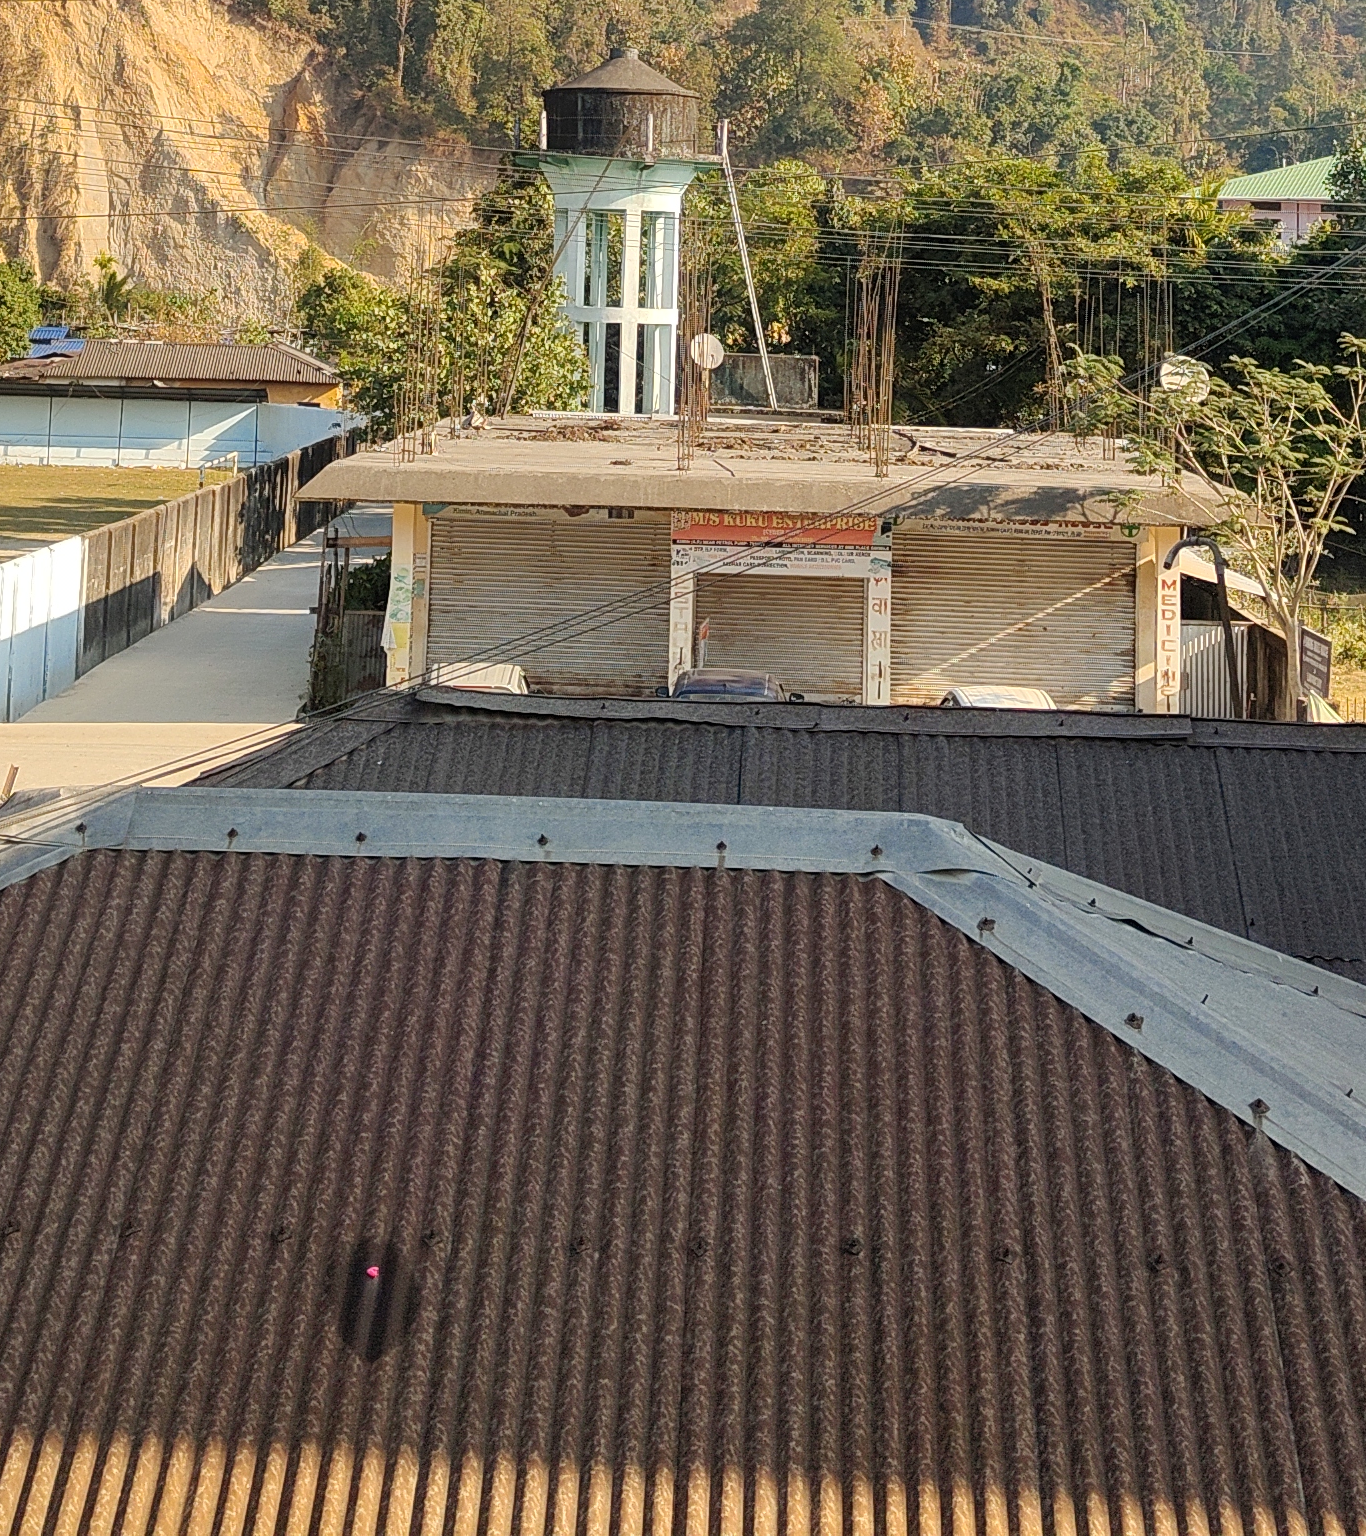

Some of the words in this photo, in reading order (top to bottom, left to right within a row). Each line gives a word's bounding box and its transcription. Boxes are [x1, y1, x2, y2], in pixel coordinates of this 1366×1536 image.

[452, 507, 473, 515] Kimin,
[691, 512, 720, 526] M/S
[723, 513, 768, 528] KUKU
[772, 515, 877, 532] ENTERPRISE
[1161, 579, 1178, 697] MEDICINE
